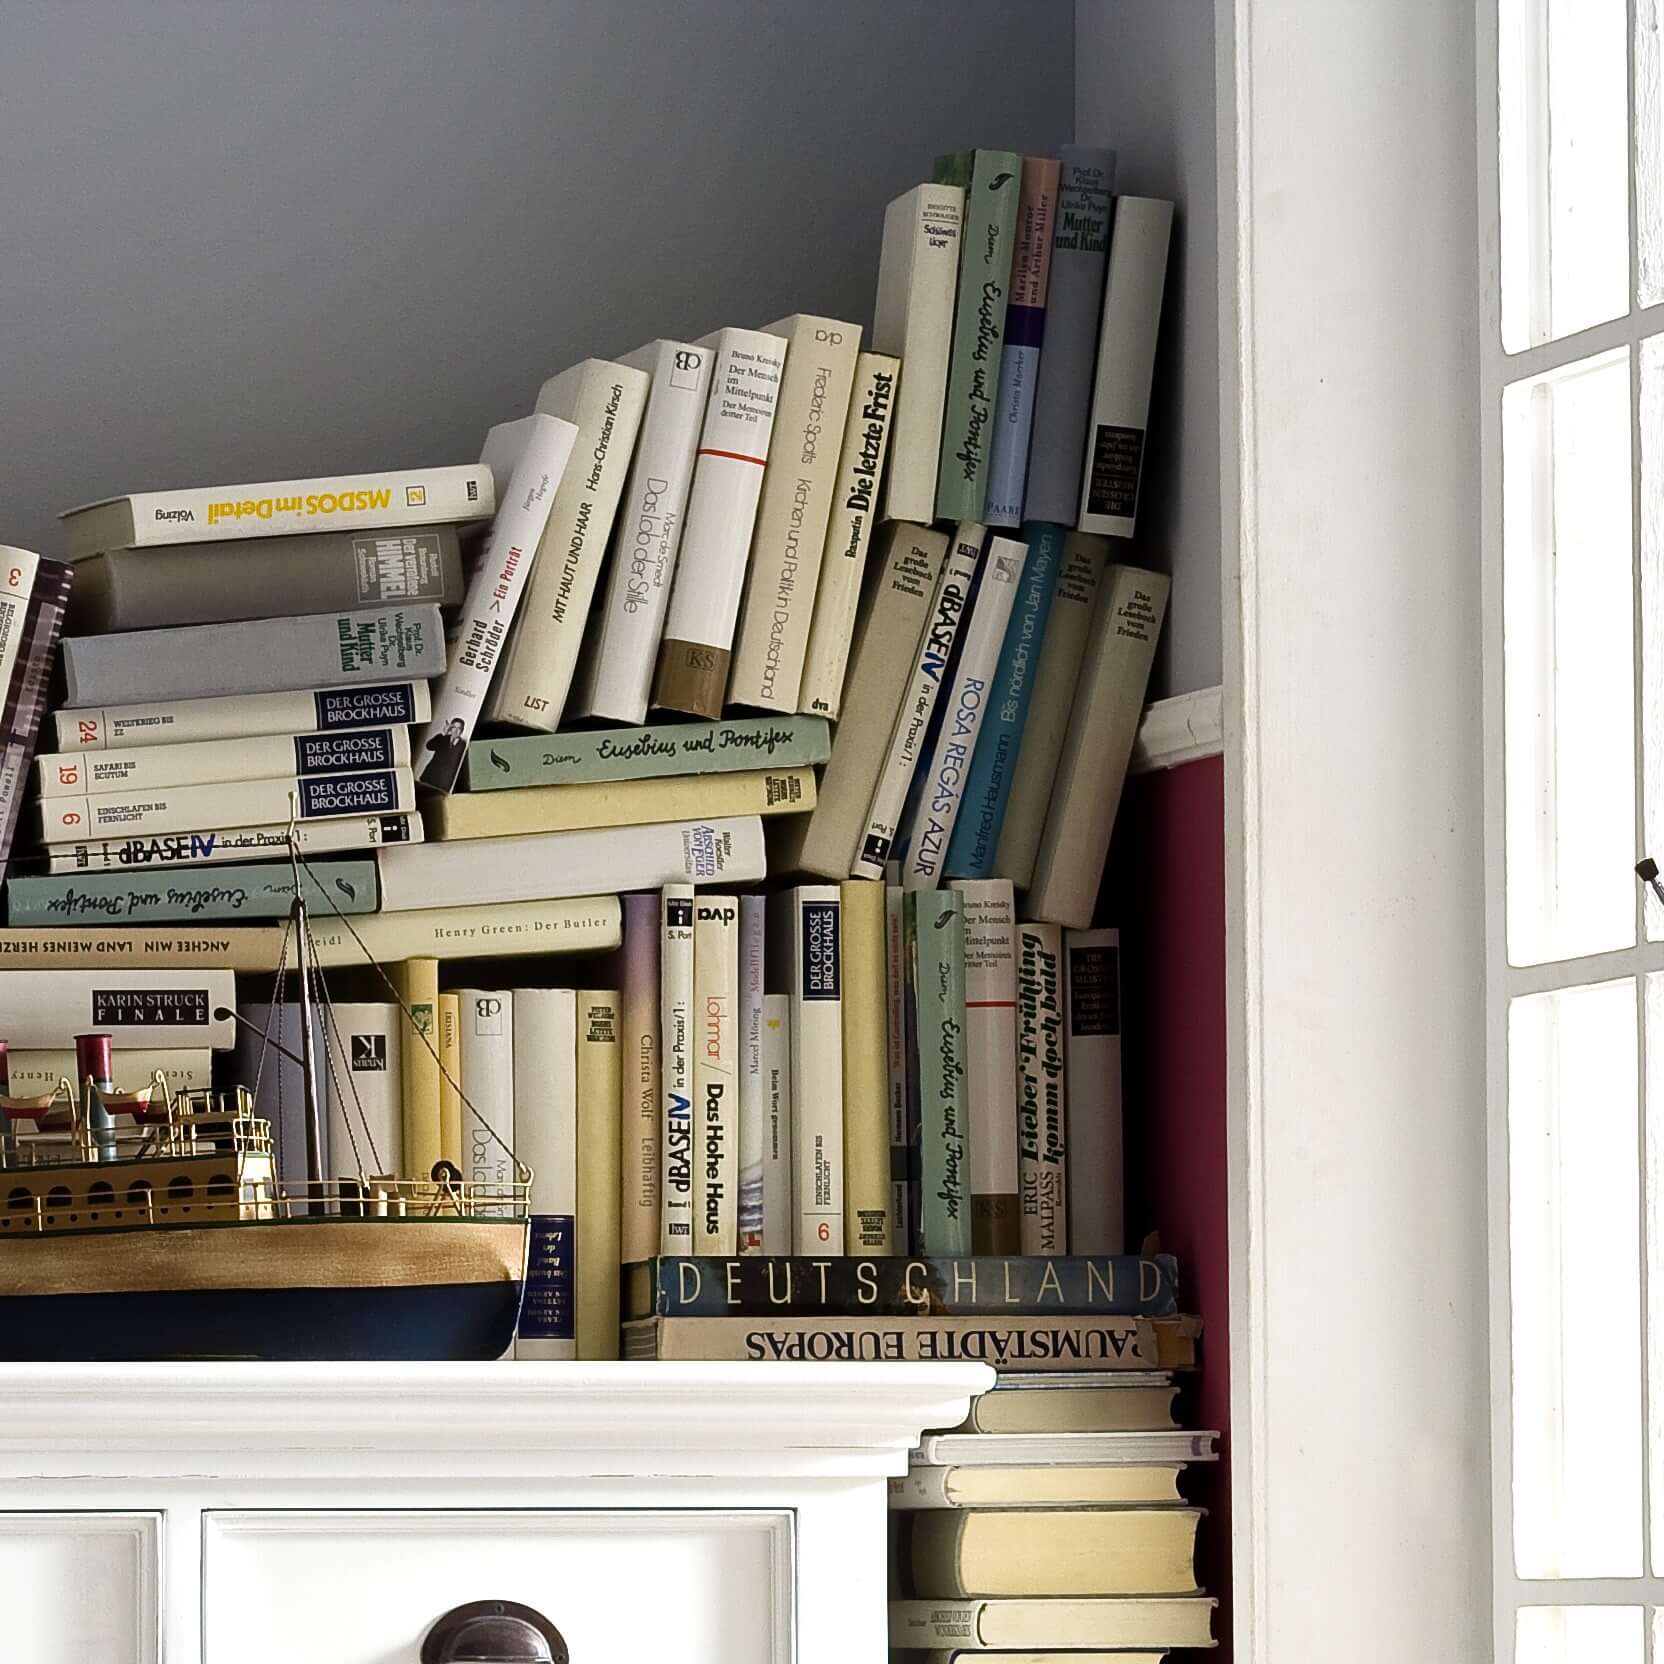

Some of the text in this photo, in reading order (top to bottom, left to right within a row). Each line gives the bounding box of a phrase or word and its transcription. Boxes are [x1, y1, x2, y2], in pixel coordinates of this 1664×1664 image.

[729, 365, 778, 383] Der Mensch
[726, 385, 773, 403] Mittelpunkt
[587, 384, 623, 491] Hans-Christian Kirsch
[848, 373, 892, 512] Die letzte Frist
[156, 509, 194, 522] Völzing
[208, 489, 390, 524] MSDOS im Detail
[845, 516, 862, 558] Rasputin
[494, 546, 522, 601] Ein Porträt
[552, 503, 592, 623] MIT HAUT UND HAAR
[460, 620, 504, 672] Gerhard Schröder
[327, 691, 403, 709] DER GROSSE
[327, 704, 405, 722] BROCKHAUS
[524, 696, 549, 712] LIST
[79, 720, 97, 744] 24
[597, 729, 676, 760] Eusebius
[683, 736, 714, 752] und
[718, 728, 794, 752] Pontifex
[59, 765, 78, 785] 19
[435, 917, 607, 938] Henry Green: Der Butler
[698, 908, 735, 926] dva
[43, 942, 92, 952] MEINES
[97, 941, 132, 951] LAND
[145, 941, 172, 951] MIN
[177, 941, 230, 951] ANCHEE
[809, 912, 821, 990] DER GROSSE
[824, 911, 834, 990] BROCKHAUS
[98, 994, 204, 1006] KARIN STRUCK
[98, 1009, 204, 1021] FINALE
[1019, 933, 1043, 1164] Lieber Frühling
[1040, 953, 1064, 1165] komm doch bald
[707, 1084, 723, 1235] Das Hohe Haus
[1024, 1172, 1037, 1216] ERIC
[1041, 1172, 1054, 1250] MALPASS
[678, 1262, 1161, 1303] DEUTSCHLAND
[746, 1330, 903, 1360] EUROPAS
